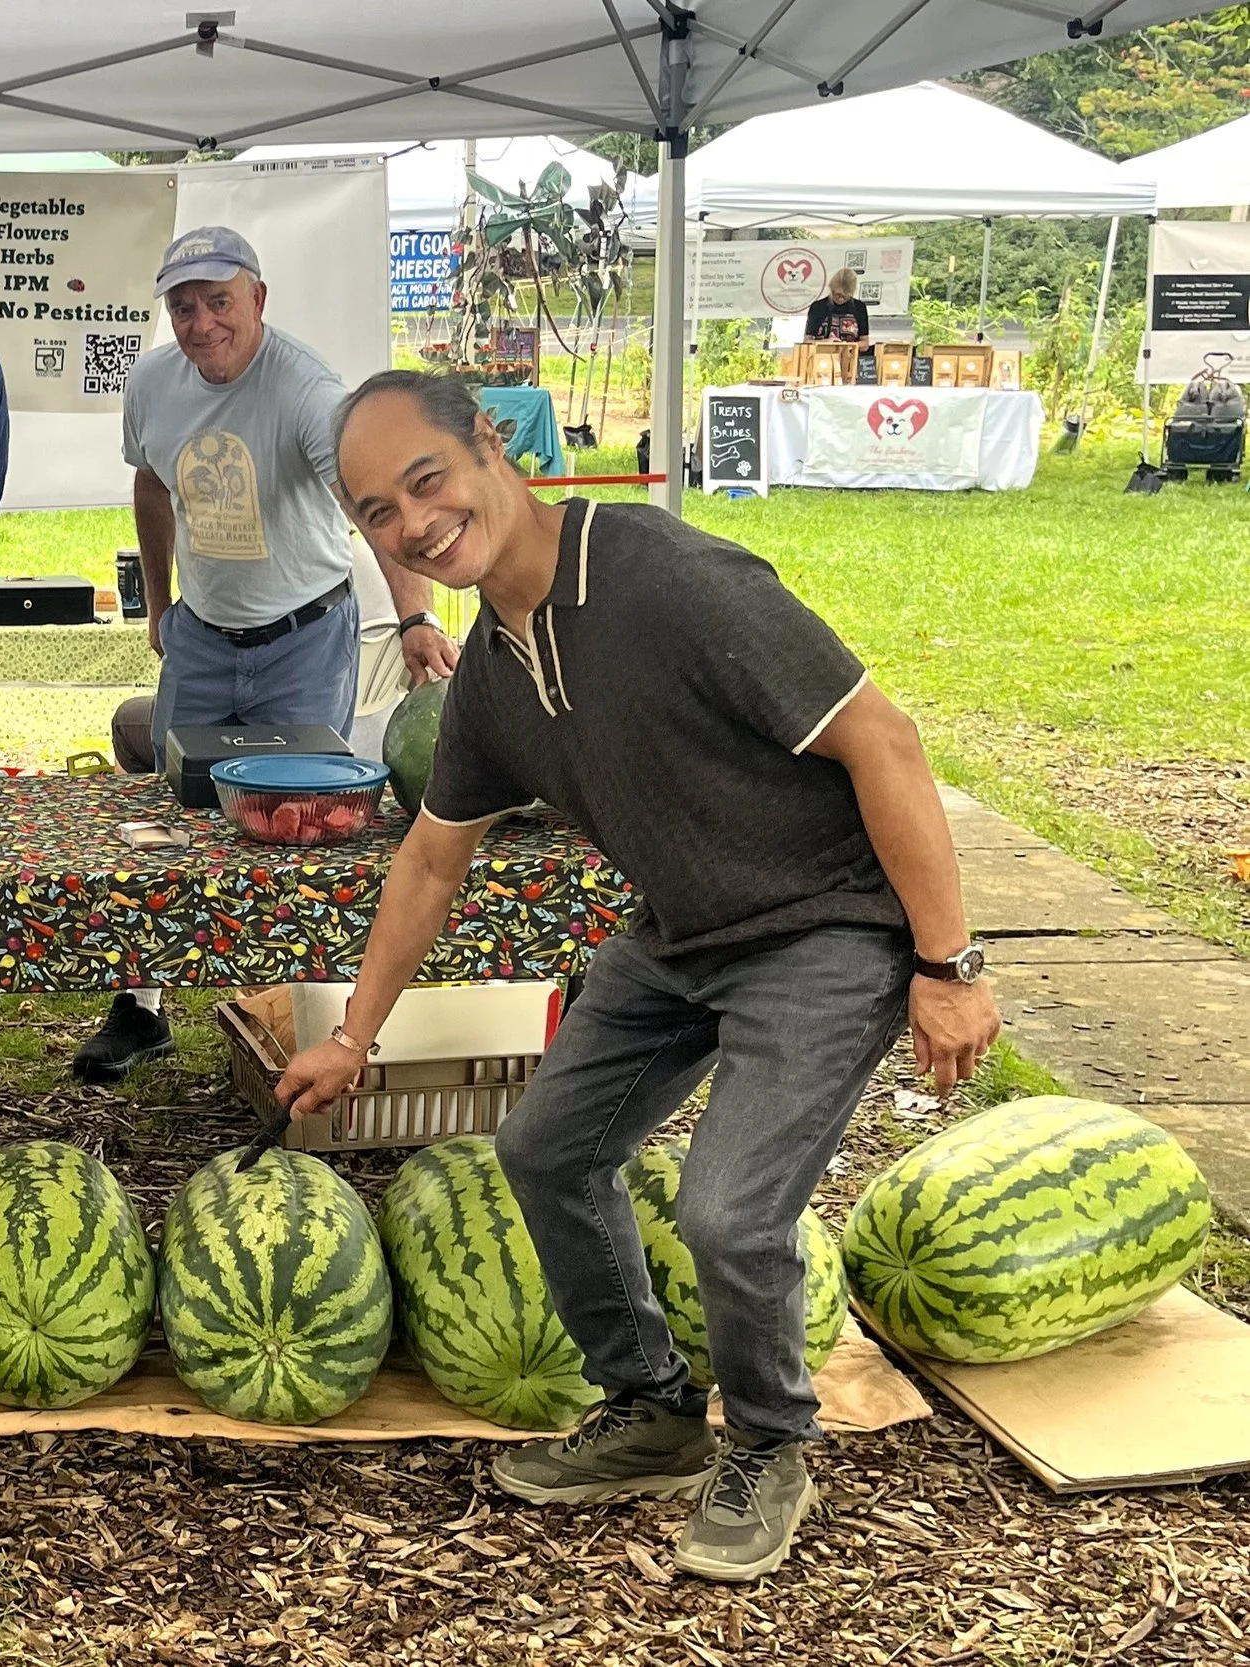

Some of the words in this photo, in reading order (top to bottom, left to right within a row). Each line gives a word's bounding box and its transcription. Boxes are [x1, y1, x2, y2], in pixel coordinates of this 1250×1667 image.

[390, 234, 418, 256] OFT
[420, 234, 451, 256] GOA
[0, 248, 54, 265] Herbs
[3, 275, 49, 292] IPM
[391, 285, 407, 295] ACK
[392, 296, 409, 308] RTH
[412, 295, 451, 308] CAROLIN
[34, 303, 150, 323] Pesticides
[710, 401, 752, 418] TREATS
